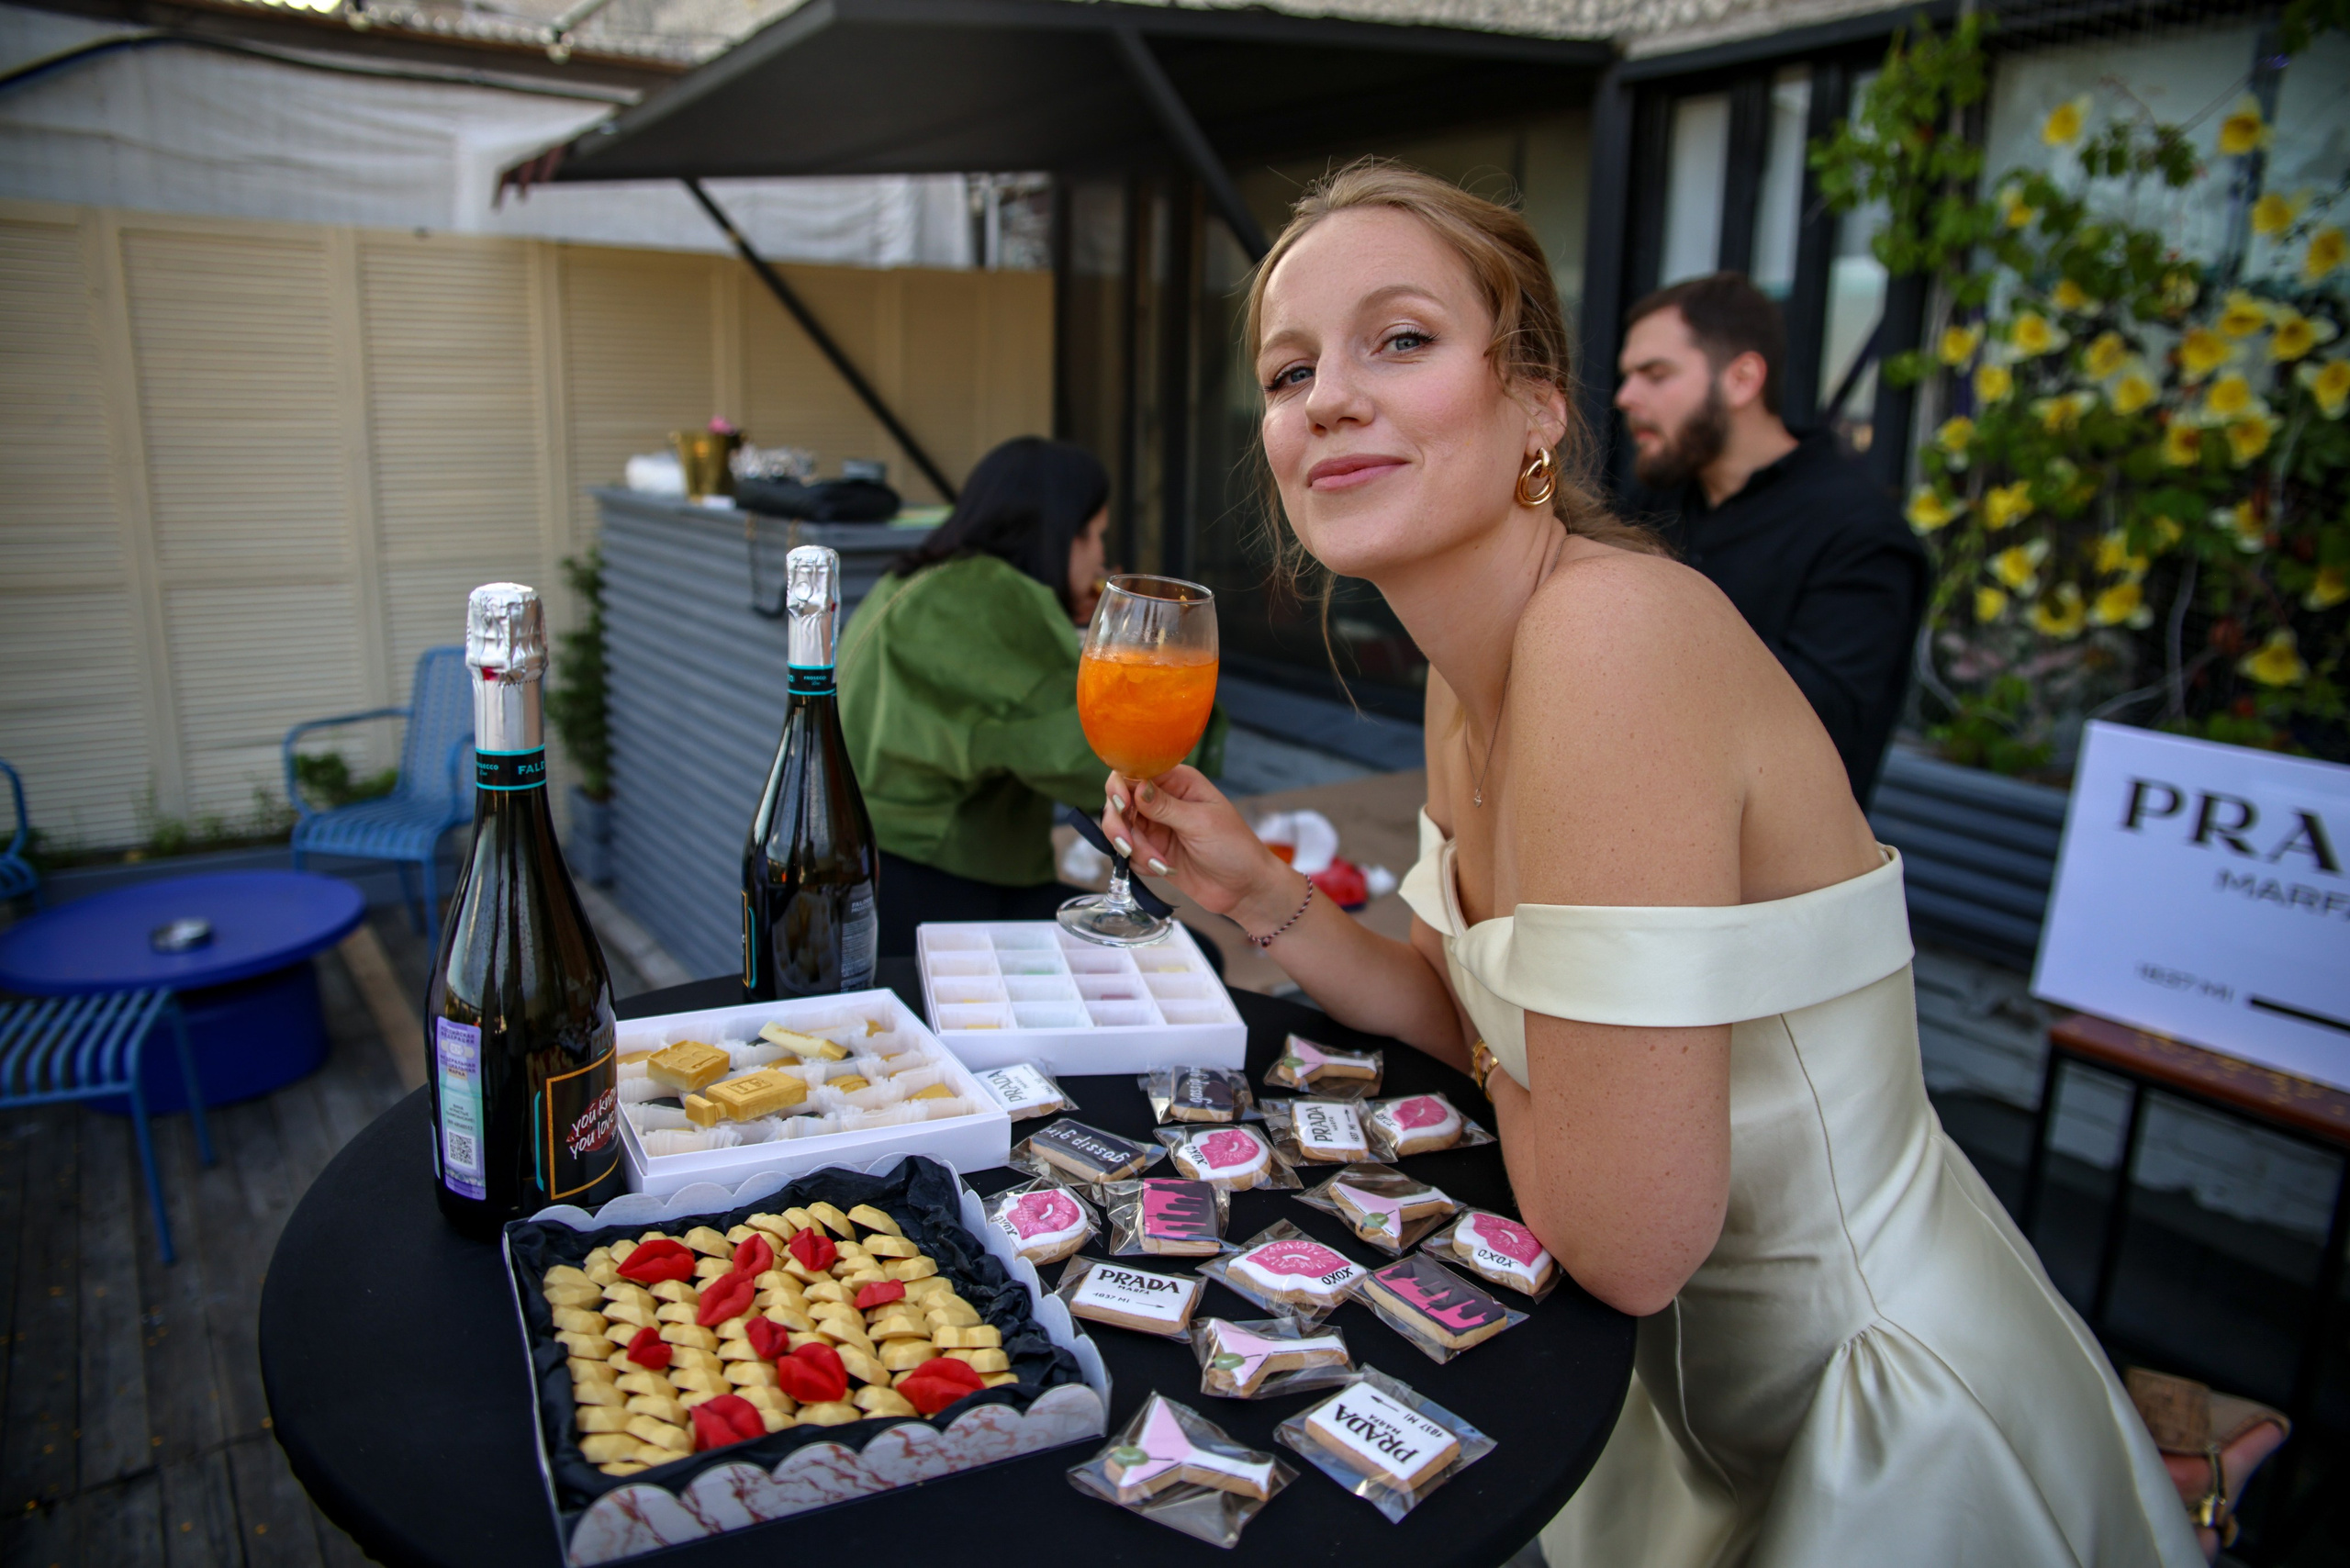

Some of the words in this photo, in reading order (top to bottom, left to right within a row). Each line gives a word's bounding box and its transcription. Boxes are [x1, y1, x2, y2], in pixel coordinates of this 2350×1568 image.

[2117, 774, 2346, 878] PRA
[2215, 868, 2350, 922] MARF
[988, 1070, 1027, 1103] PRADA
[569, 1130, 595, 1160] you
[598, 1110, 615, 1139] love
[572, 1111, 596, 1138] you
[1305, 1105, 1334, 1142] PRADA
[1071, 1136, 1130, 1163] gossip
[1097, 1269, 1181, 1294] PRADA
[1117, 1284, 1149, 1295] MARFA
[1321, 1267, 1353, 1285] XOXO
[1369, 1414, 1402, 1436] MARFA
[1404, 1413, 1419, 1424] MI
[1335, 1403, 1420, 1464] PRADA
